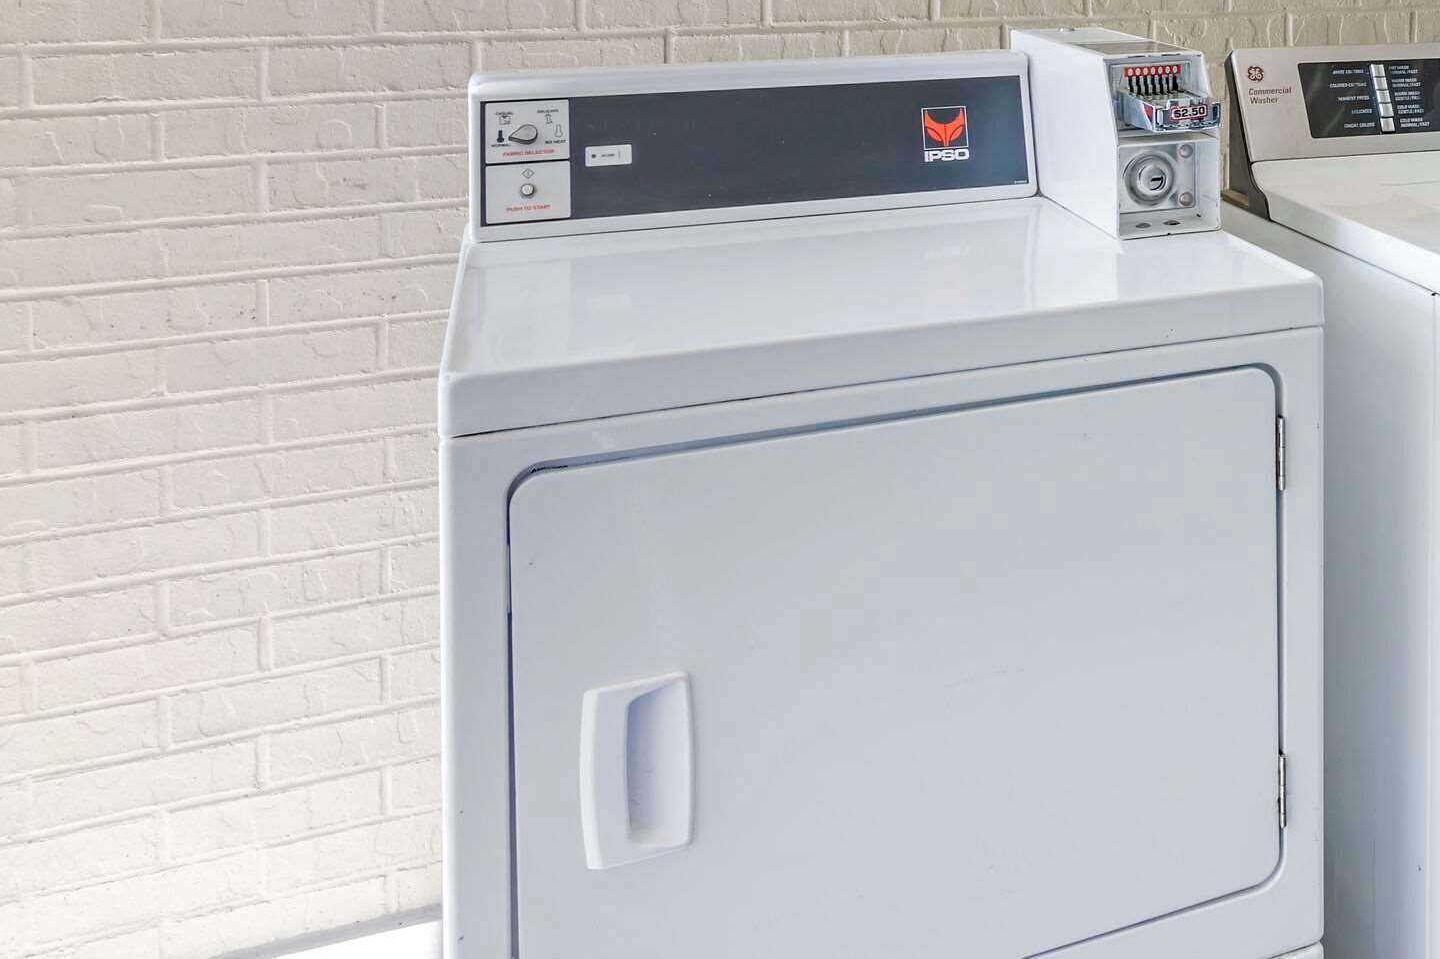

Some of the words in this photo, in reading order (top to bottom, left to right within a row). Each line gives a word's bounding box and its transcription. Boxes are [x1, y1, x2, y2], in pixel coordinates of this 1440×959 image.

[1248, 86, 1292, 96] Commercial
[1250, 96, 1280, 104] Washer
[1174, 106, 1205, 118] $2.50
[924, 148, 970, 163] IPSO
